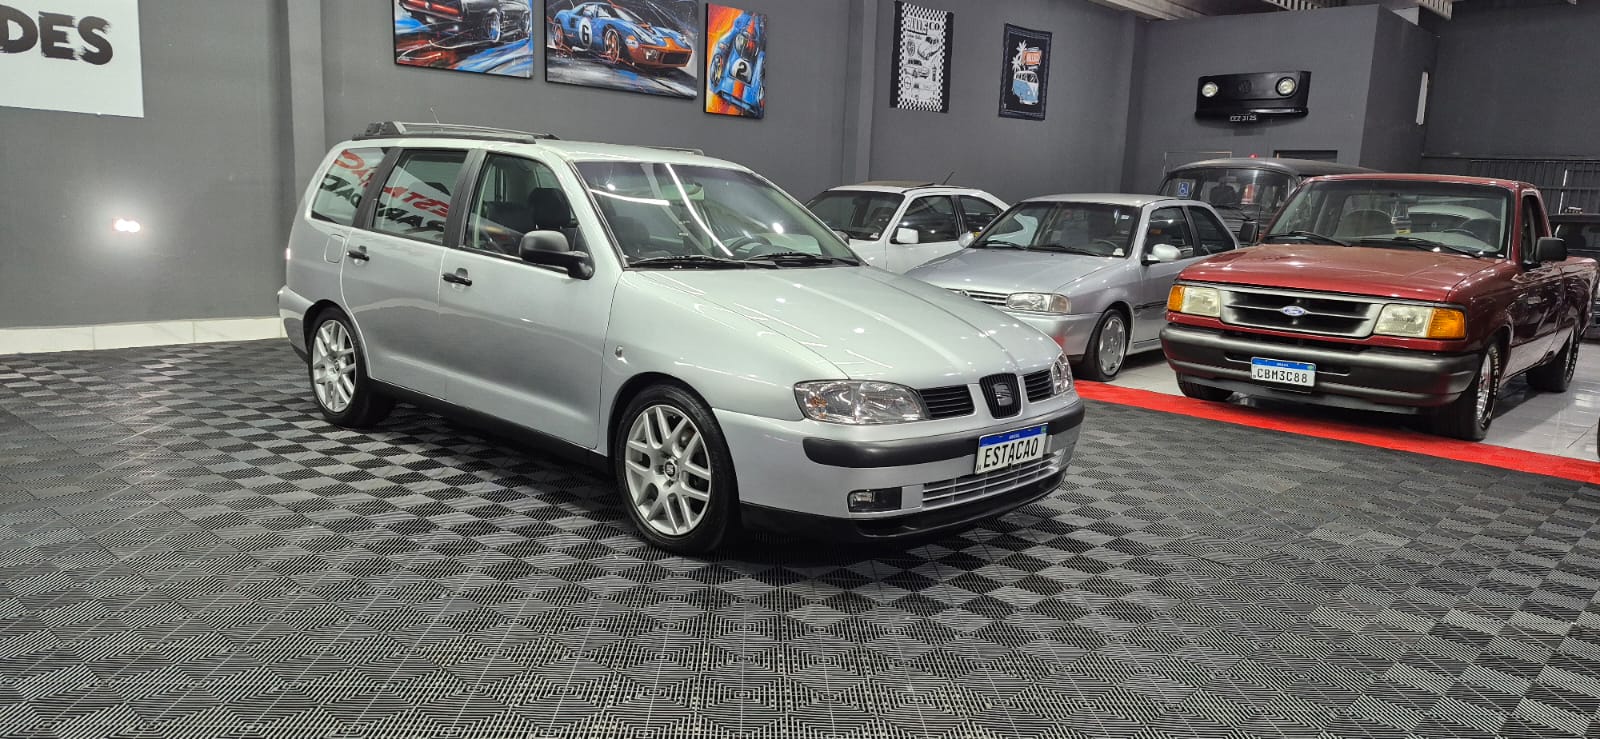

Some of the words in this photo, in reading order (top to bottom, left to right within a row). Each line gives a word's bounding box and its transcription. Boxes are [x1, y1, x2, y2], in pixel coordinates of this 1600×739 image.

[580, 24, 590, 45] 6
[735, 61, 748, 79] 2
[1257, 368, 1307, 383] CBM3C88
[984, 437, 1038, 469] ESTACAO
